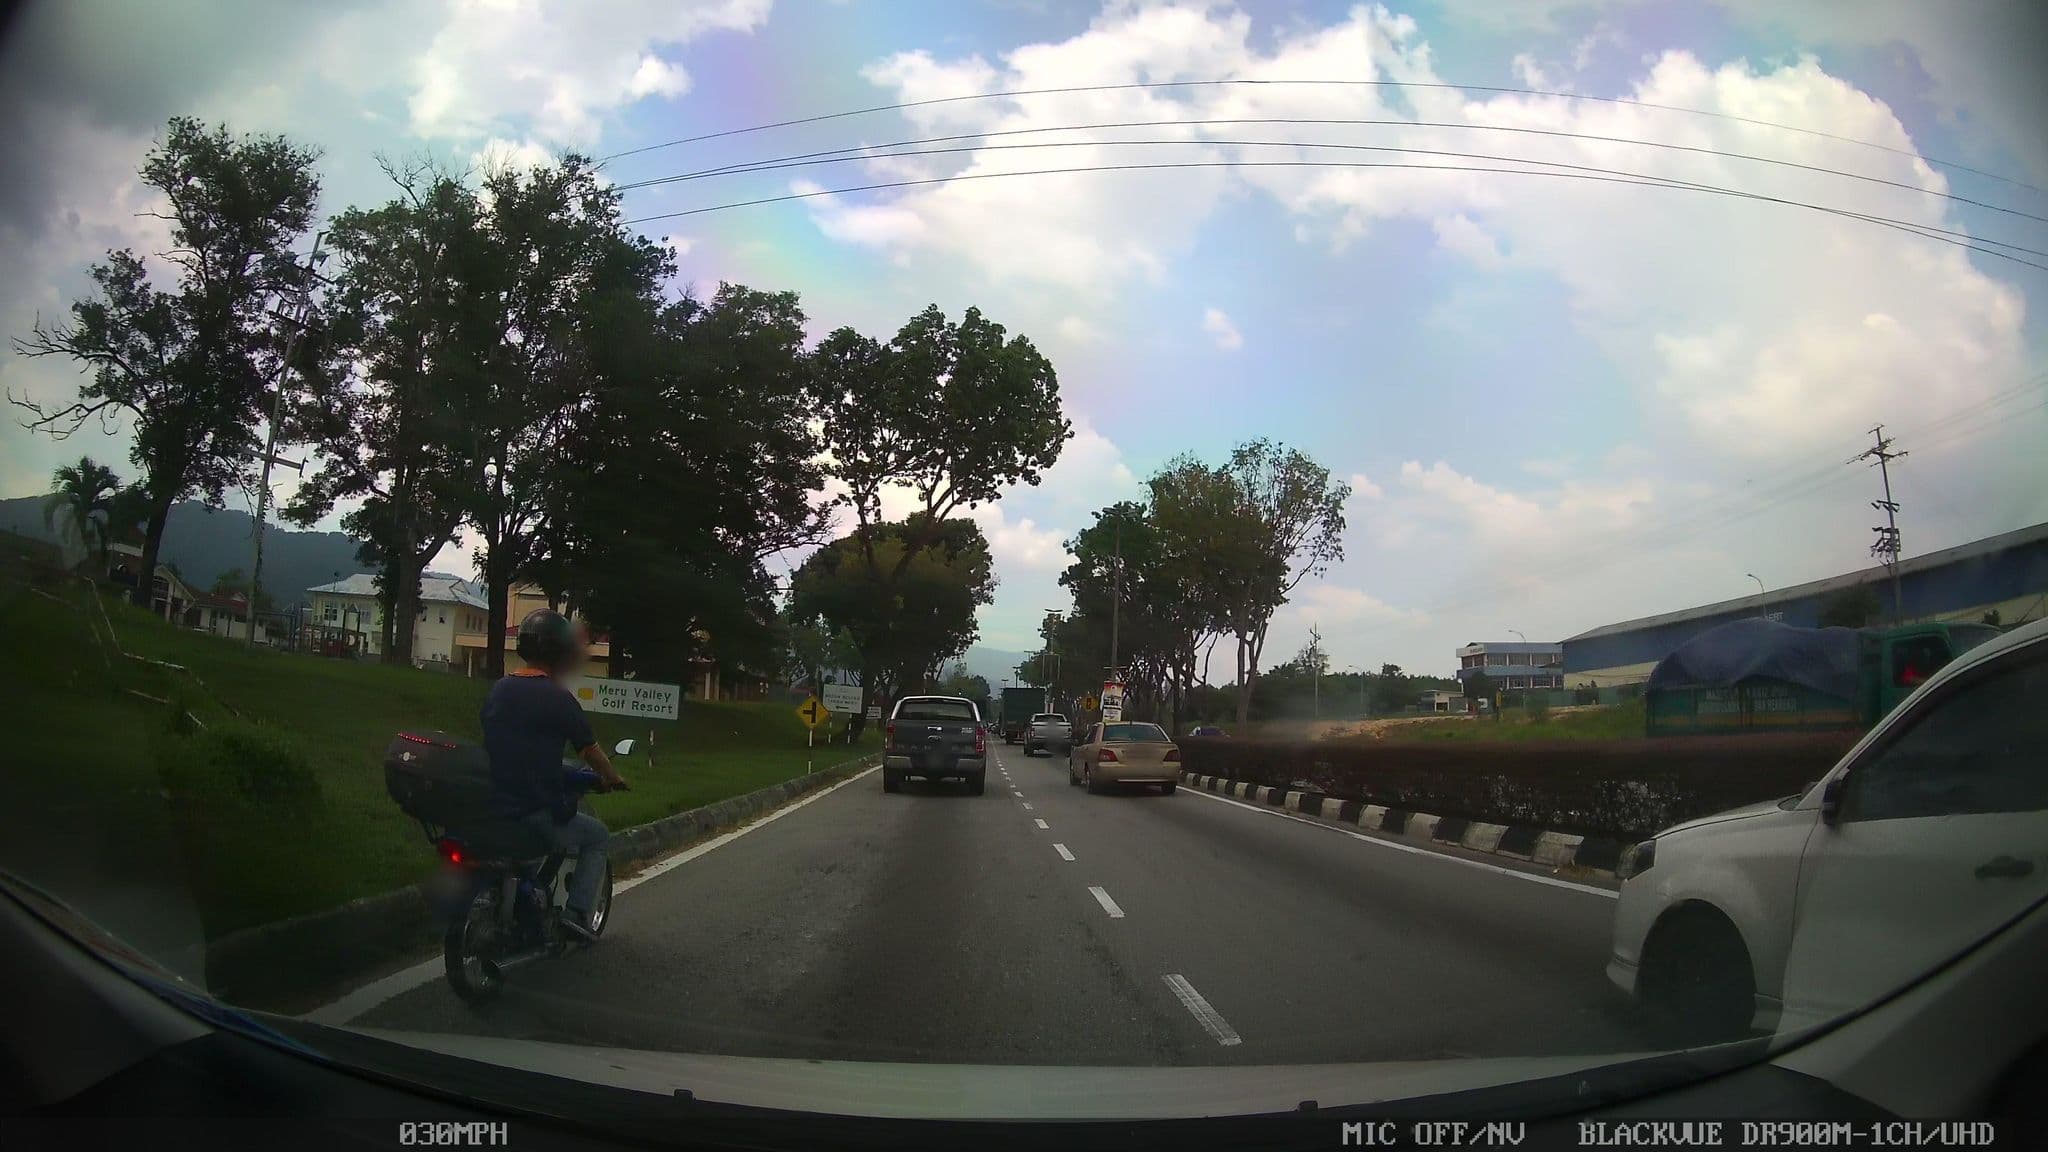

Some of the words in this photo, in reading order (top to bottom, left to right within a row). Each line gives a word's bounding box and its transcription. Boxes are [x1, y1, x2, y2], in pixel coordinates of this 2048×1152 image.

[598, 684, 628, 697] Meru
[633, 687, 672, 703] Valley
[601, 698, 626, 709] Golf
[631, 700, 673, 714] Resort
